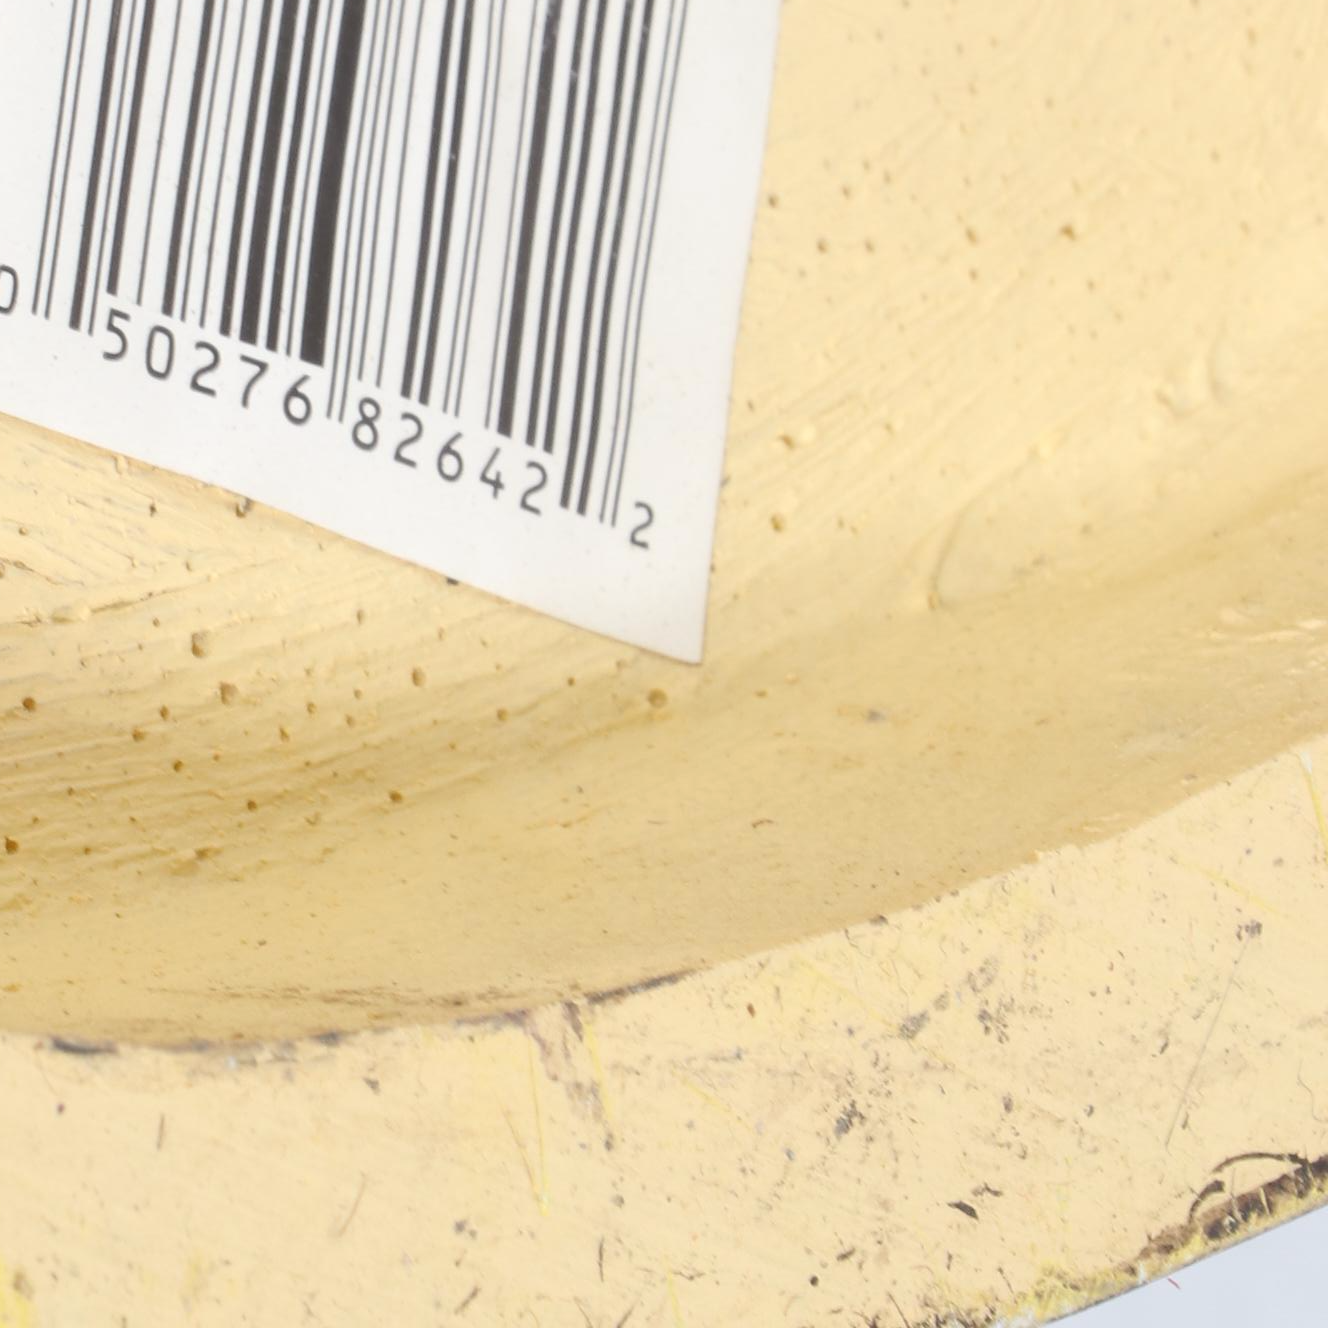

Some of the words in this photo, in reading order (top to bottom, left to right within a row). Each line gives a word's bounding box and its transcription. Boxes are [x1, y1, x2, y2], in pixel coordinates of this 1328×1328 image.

[102, 307, 313, 426] 50276
[352, 396, 550, 515] 82642
[628, 502, 656, 551] 2
